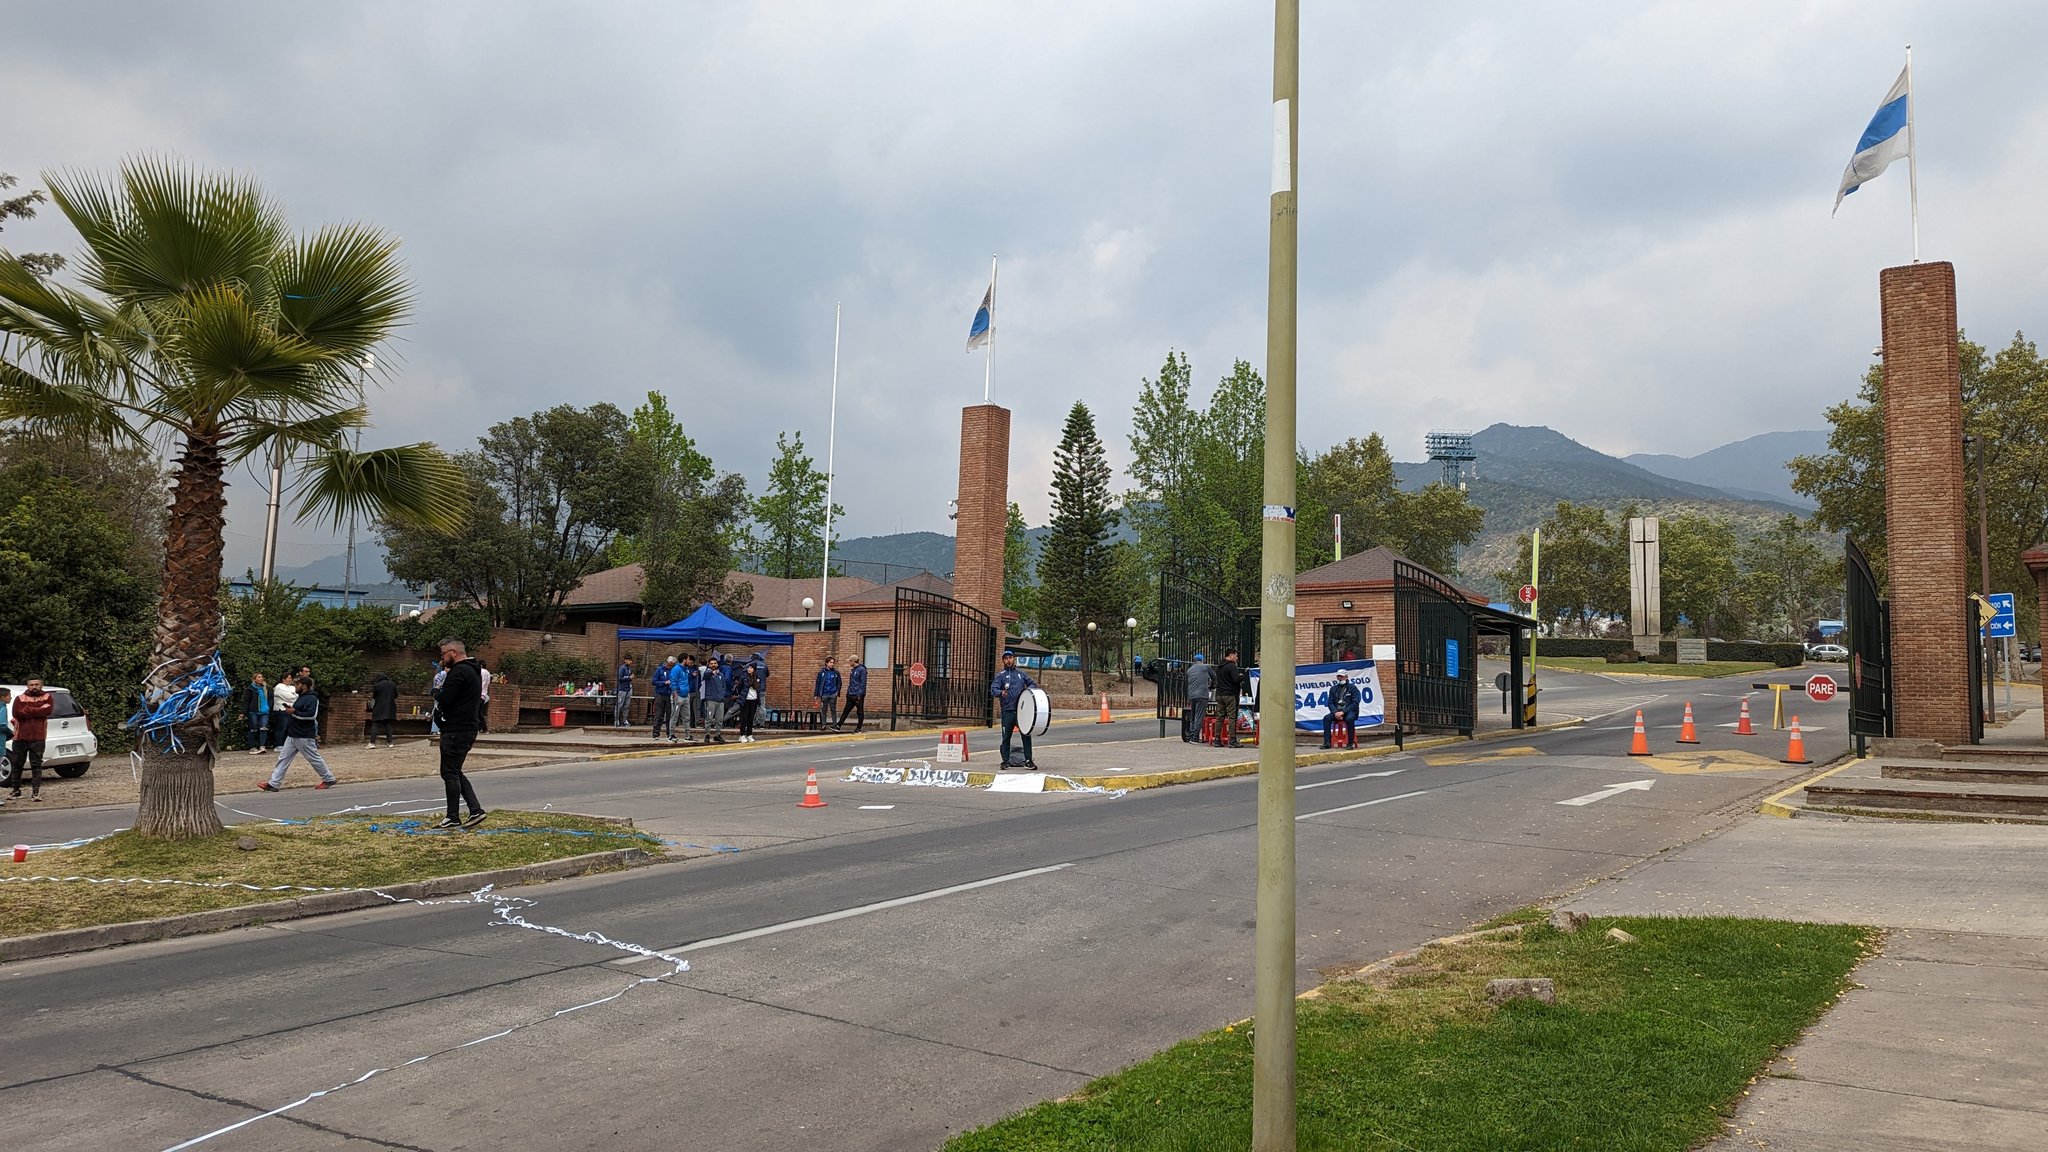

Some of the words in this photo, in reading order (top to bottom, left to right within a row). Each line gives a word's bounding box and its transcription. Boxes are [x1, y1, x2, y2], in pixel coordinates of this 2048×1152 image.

[910, 670, 926, 679] PARE
[1300, 680, 1332, 690] HUELGA
[1350, 676, 1371, 685] SOLO
[1809, 682, 1834, 695] PARE
